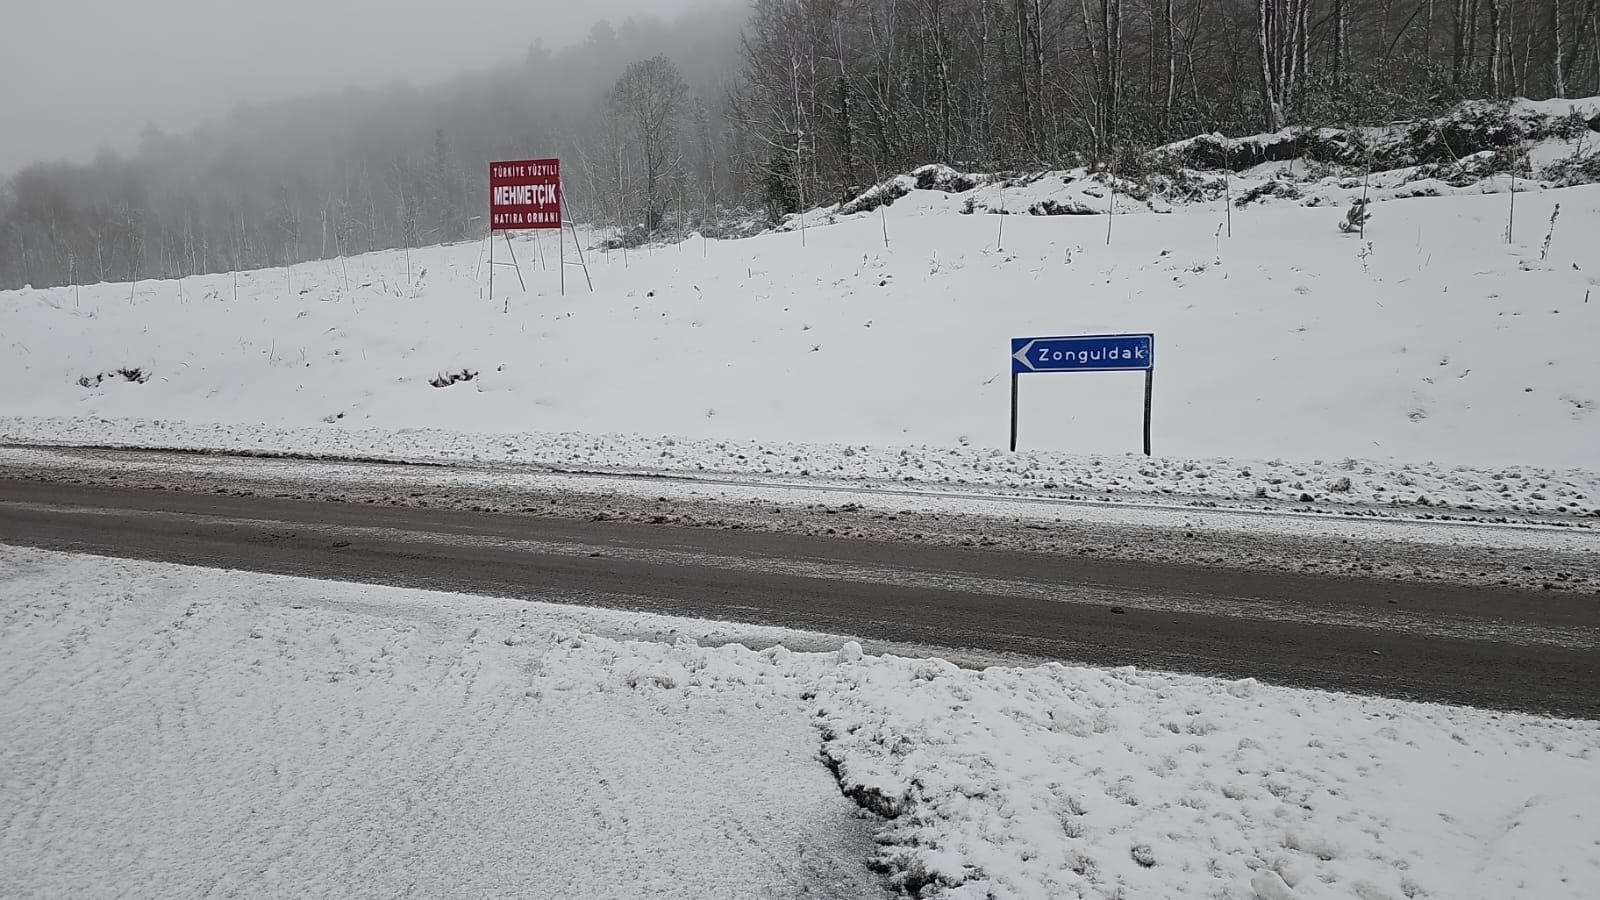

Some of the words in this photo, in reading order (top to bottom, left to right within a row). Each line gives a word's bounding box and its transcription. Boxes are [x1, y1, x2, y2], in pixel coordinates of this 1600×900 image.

[493, 165, 524, 177] TÜRKİYE
[528, 163, 557, 176] YÜZYILI
[494, 179, 557, 209] MEHMETÇİK
[494, 212, 523, 224] HATIRA
[527, 211, 558, 223] ORMANI
[1039, 346, 1145, 363] Zonguldak
